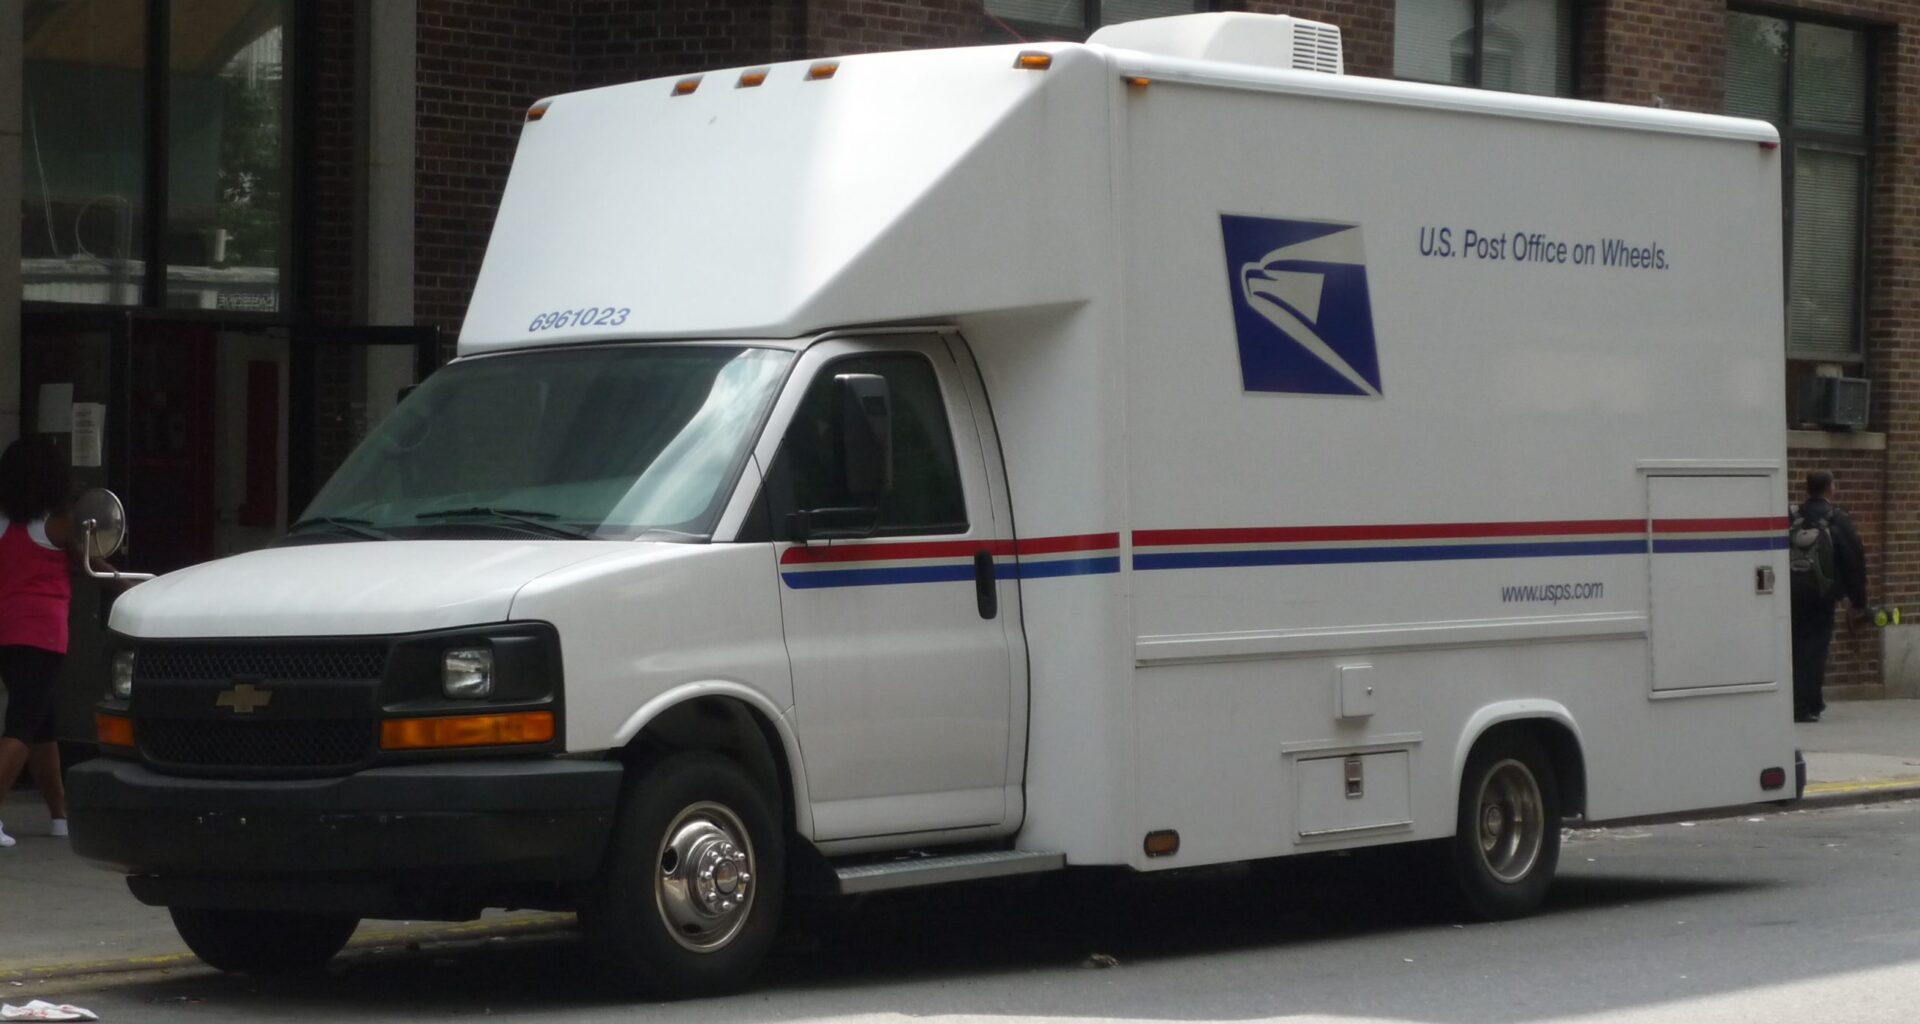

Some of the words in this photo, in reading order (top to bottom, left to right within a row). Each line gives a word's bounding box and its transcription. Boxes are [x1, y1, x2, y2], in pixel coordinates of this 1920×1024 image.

[1419, 226, 1456, 257] U.S.
[1463, 229, 1507, 260] Post
[1512, 231, 1568, 264] Office
[1573, 243, 1596, 265] on
[1601, 237, 1670, 270] Wheels.
[528, 307, 631, 332] 6961023
[1501, 581, 1604, 606] www.usps.com
